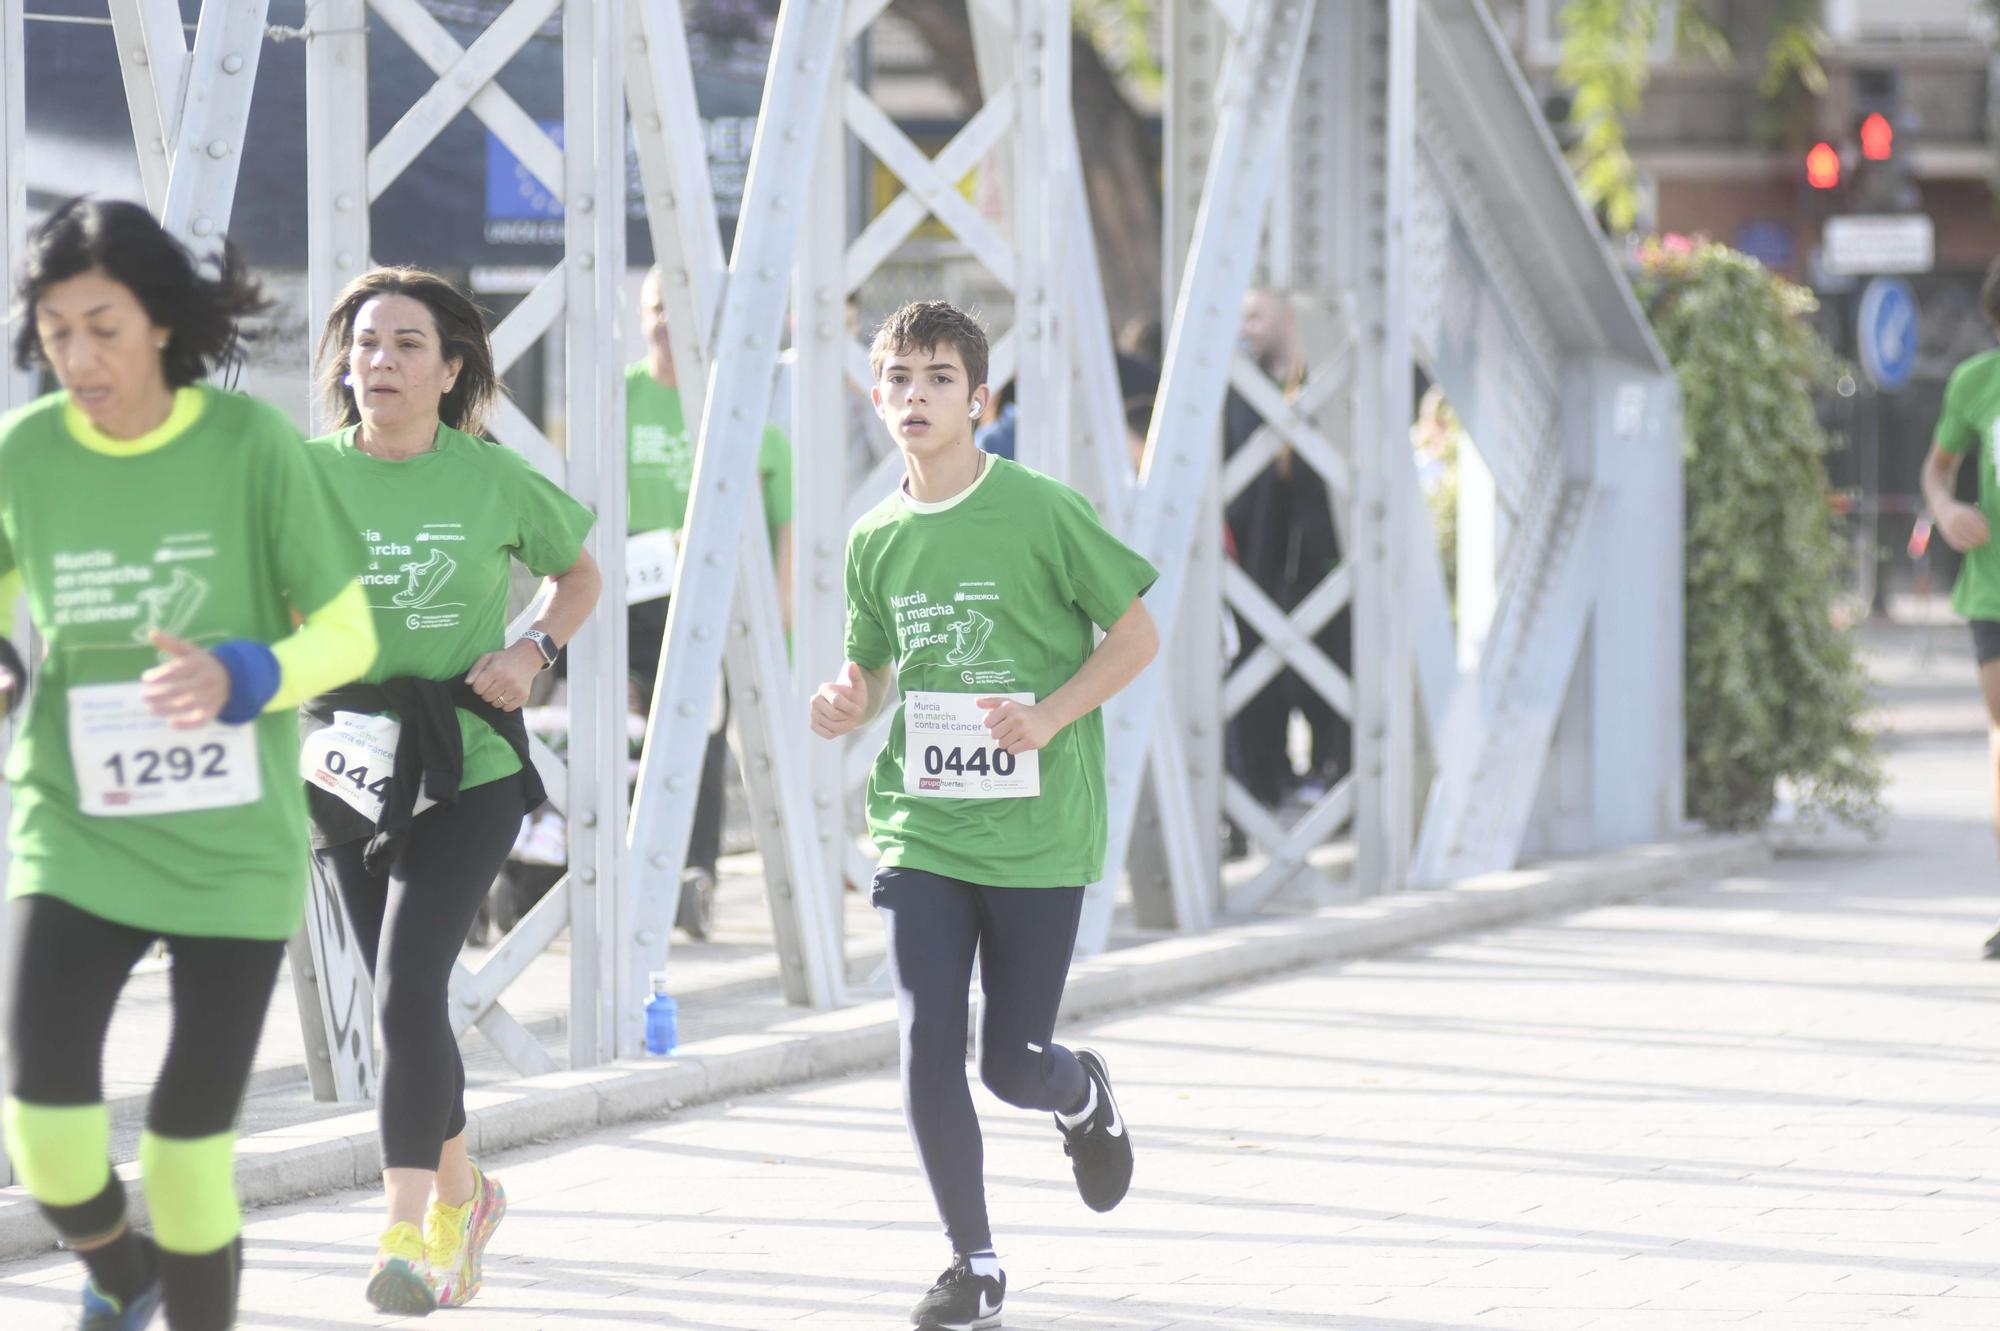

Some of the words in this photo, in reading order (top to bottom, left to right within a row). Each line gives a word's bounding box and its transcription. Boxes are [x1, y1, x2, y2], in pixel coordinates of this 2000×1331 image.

[54, 549, 115, 569] Murcia
[77, 564, 150, 585] marcha
[54, 588, 113, 606] contra
[890, 590, 928, 609] Murcia
[965, 593, 1000, 601] IBERDROLA
[907, 603, 955, 621] marcha
[898, 621, 931, 637] ontra
[909, 633, 949, 649] cáncer
[914, 702, 940, 711] Murcia
[914, 712, 924, 720] en
[925, 711, 956, 722] marcha
[914, 721, 941, 730] contra
[941, 721, 950, 731] el
[950, 721, 982, 732] cáncer
[103, 742, 228, 788] 1292
[924, 745, 1016, 776] 0440
[325, 750, 393, 805] 044
